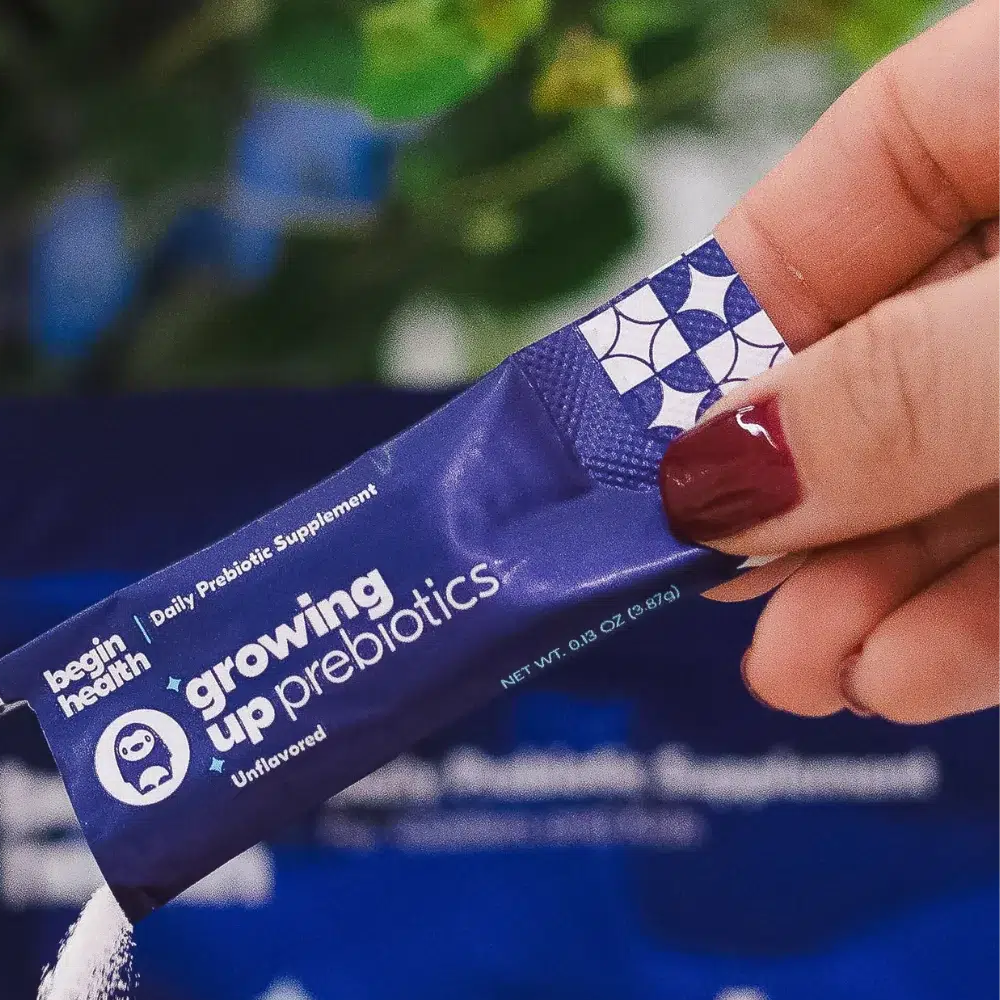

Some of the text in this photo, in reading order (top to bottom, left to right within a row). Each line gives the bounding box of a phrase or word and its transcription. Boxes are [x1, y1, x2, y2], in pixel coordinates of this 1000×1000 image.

[150, 483, 378, 627] Daily Prebiotic Supplement
[43, 634, 127, 694] begin
[57, 652, 152, 718] health
[185, 568, 394, 722] growing
[206, 562, 500, 752] up prebiotics
[500, 584, 680, 689] NET WT. 0.13 OZ (3.87g)
[231, 724, 328, 789] Unflavored
